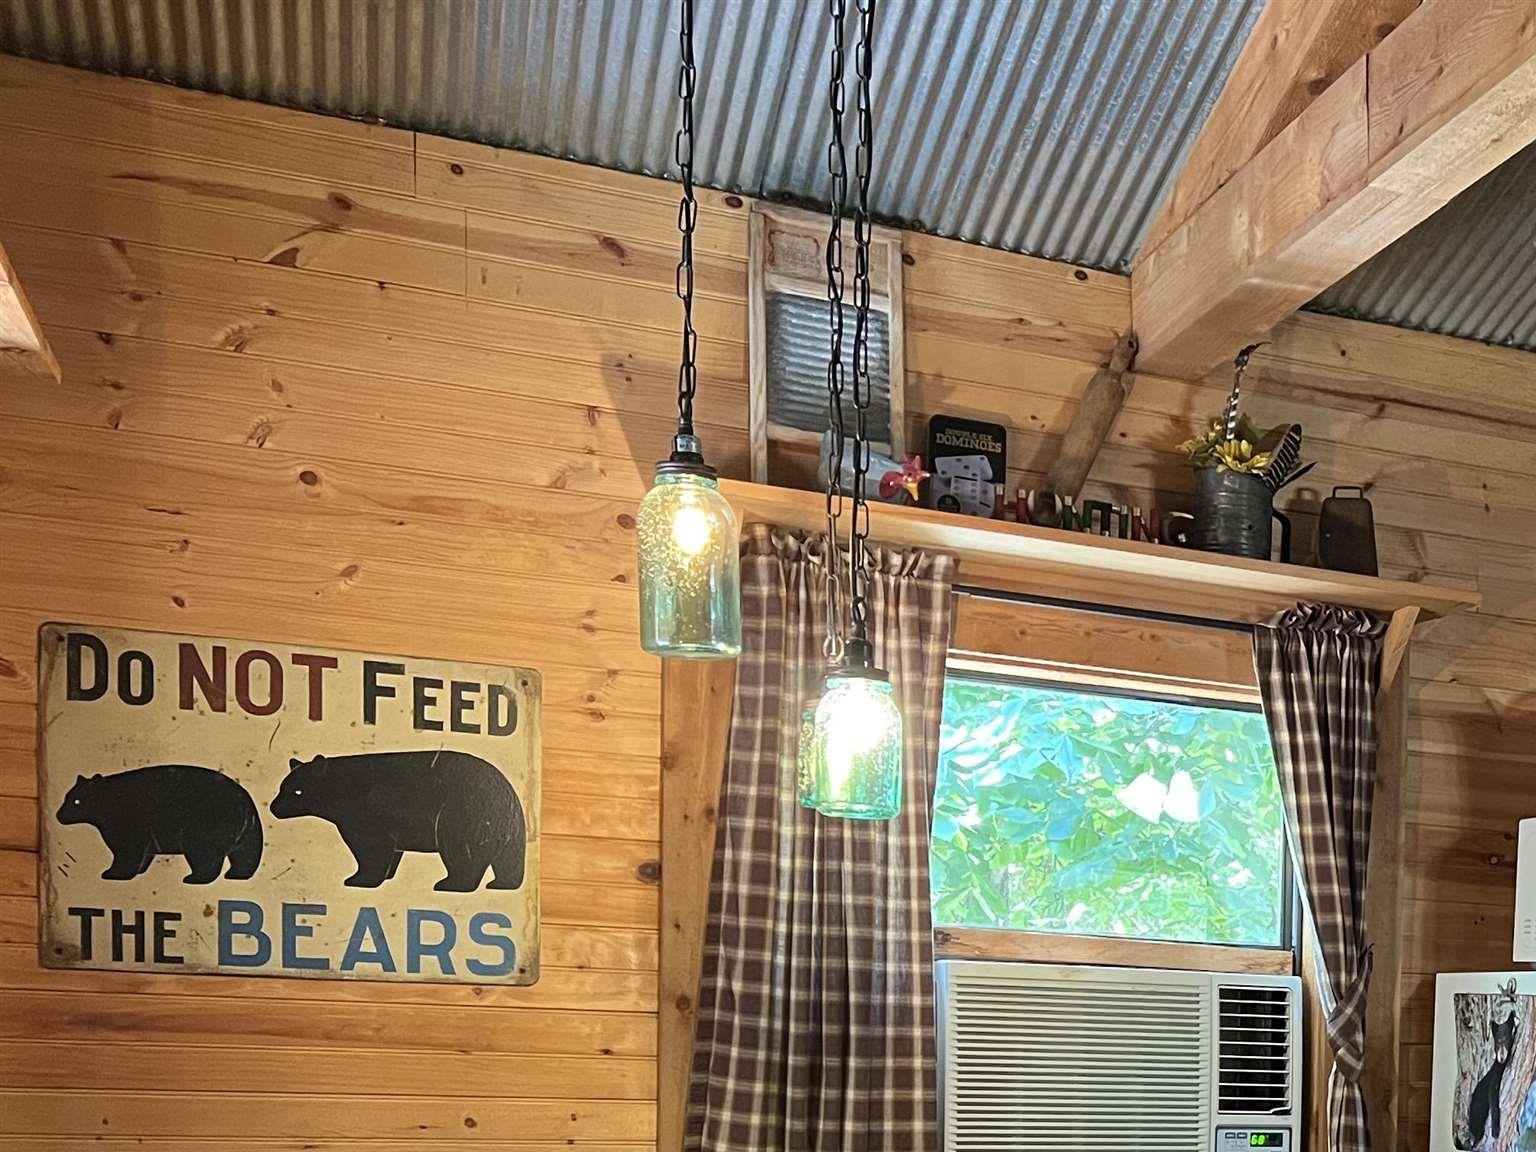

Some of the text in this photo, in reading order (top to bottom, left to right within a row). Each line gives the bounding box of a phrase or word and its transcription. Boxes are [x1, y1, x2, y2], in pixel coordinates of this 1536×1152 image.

[936, 432, 1002, 453] DOMINOES
[178, 642, 338, 722] NOT
[68, 899, 518, 977] THE BEARS
